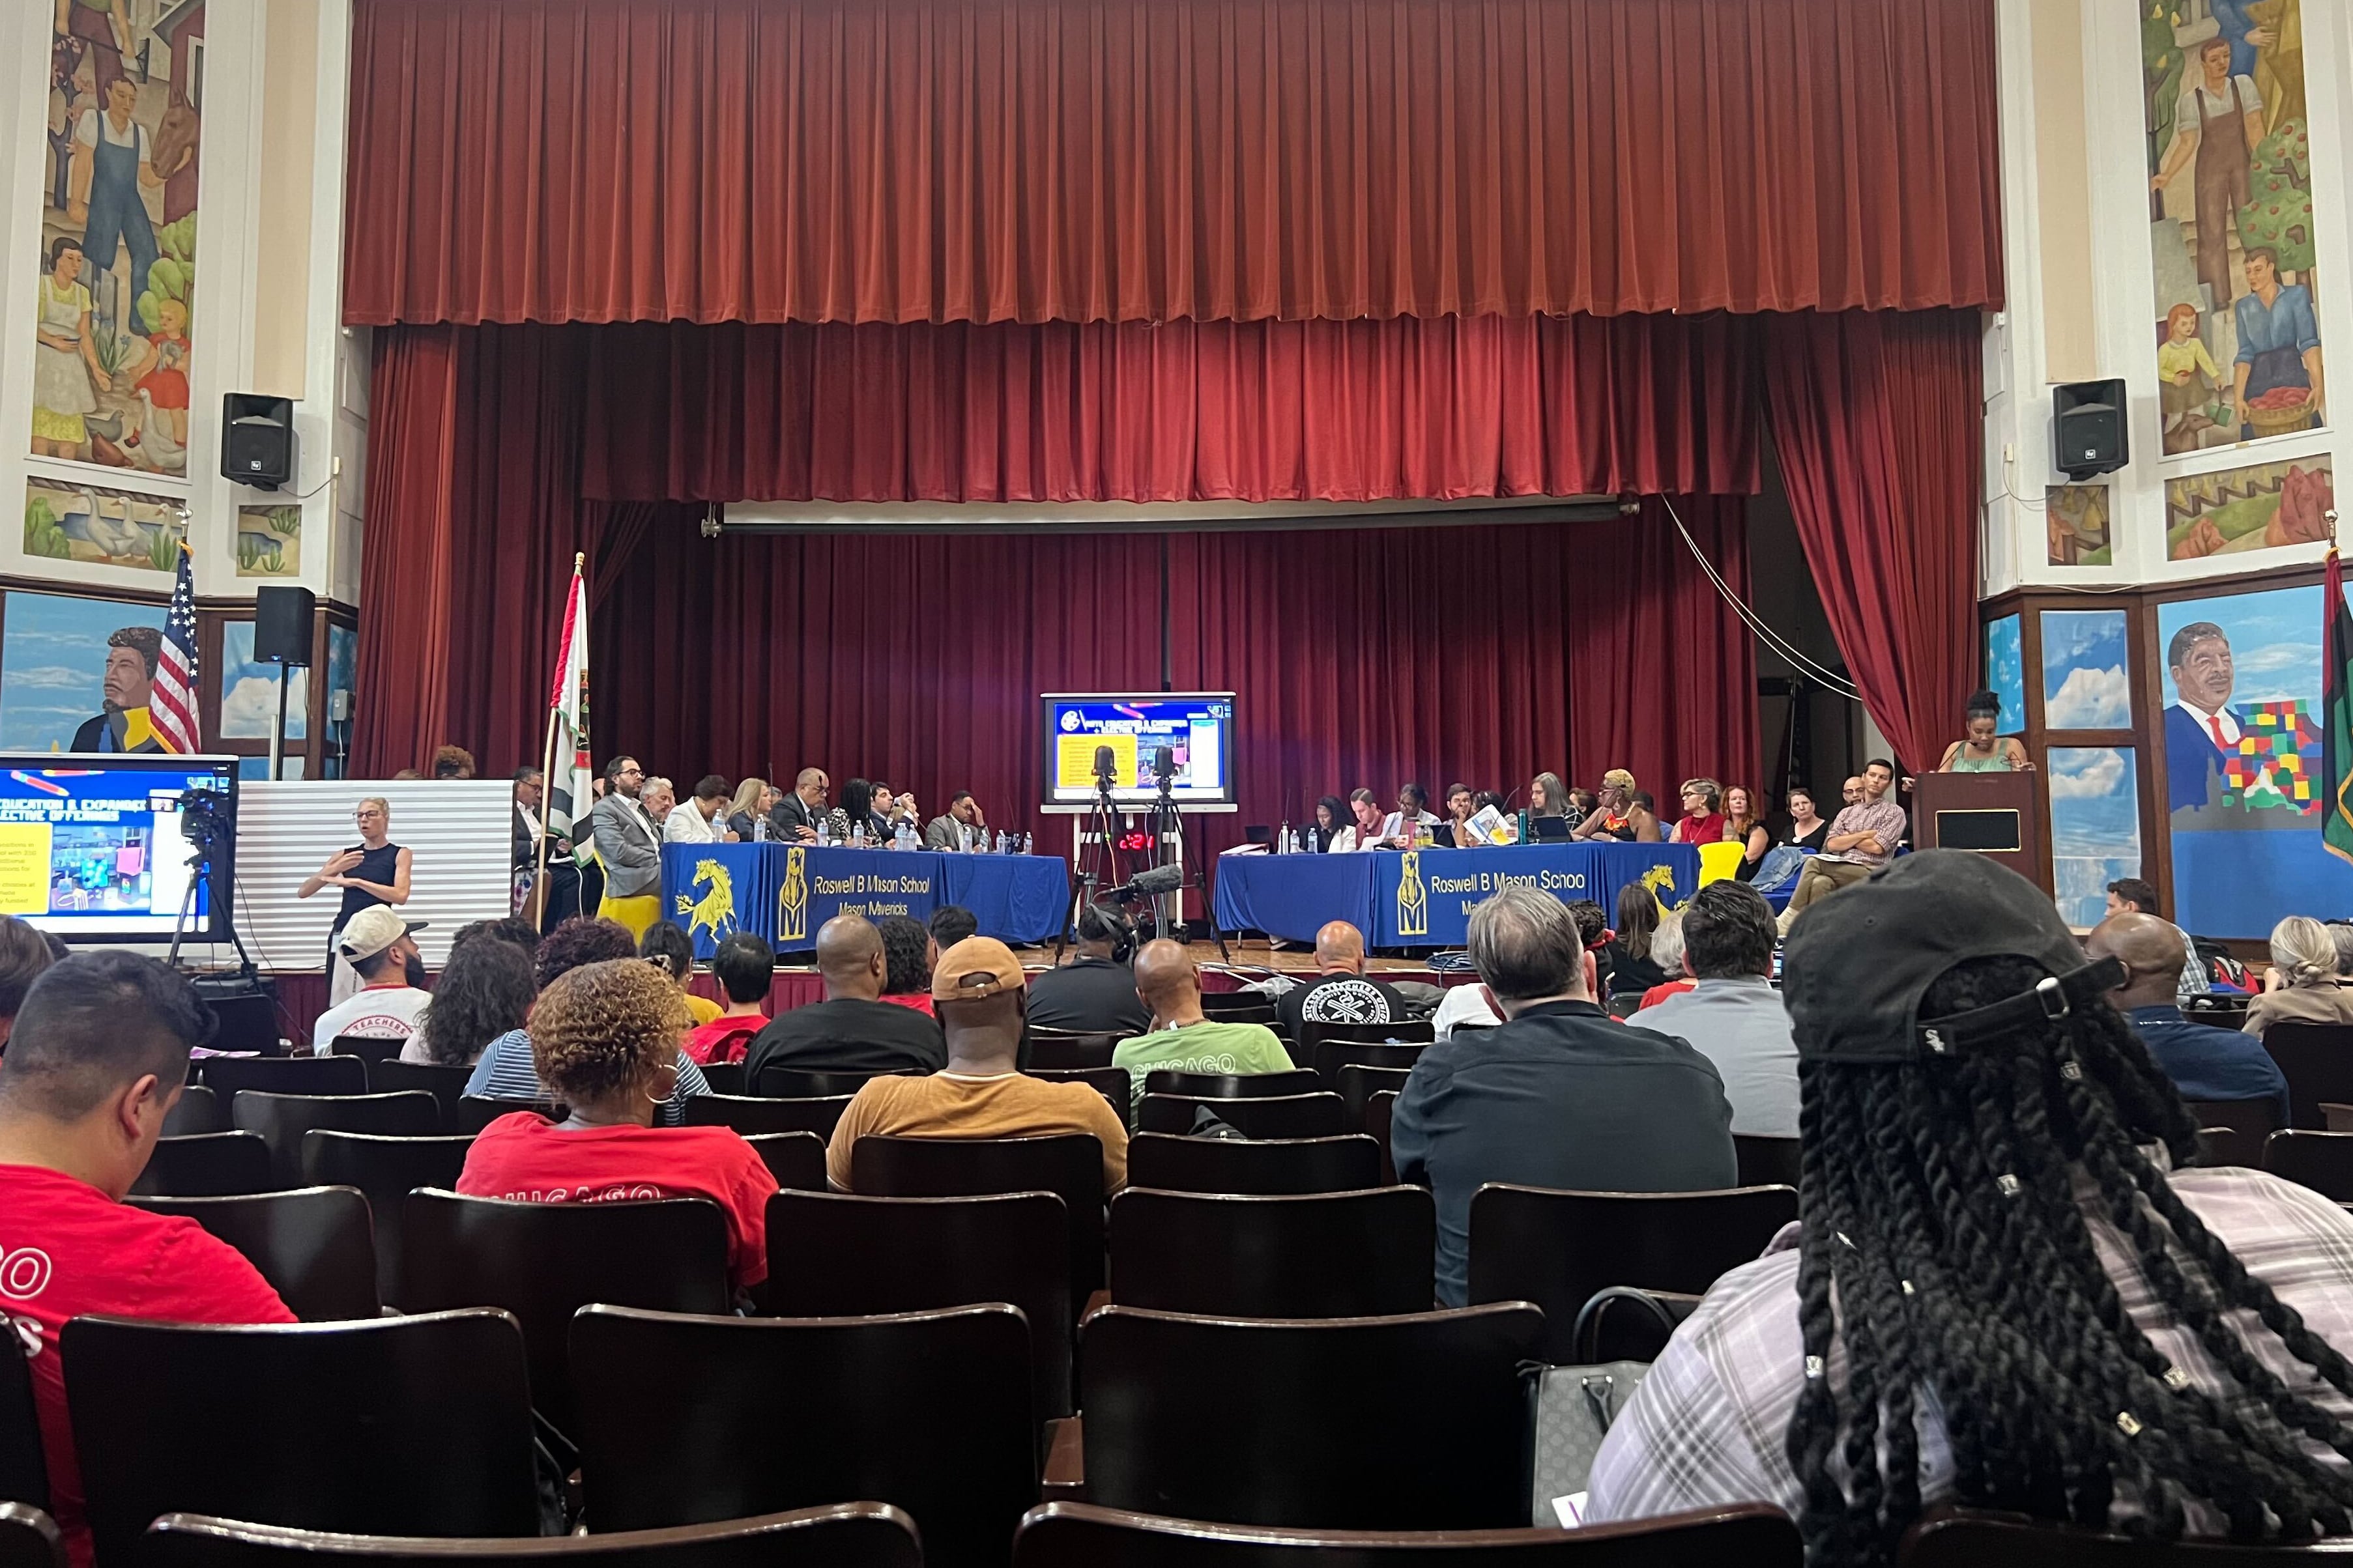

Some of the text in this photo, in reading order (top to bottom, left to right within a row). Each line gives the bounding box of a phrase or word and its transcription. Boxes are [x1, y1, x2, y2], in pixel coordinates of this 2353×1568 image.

[0, 810, 46, 821] ECTIVE
[814, 876, 855, 894] Roswell
[857, 875, 865, 893] B
[900, 876, 930, 894] School
[1432, 870, 1585, 893] Roswell B Mason Schoo
[839, 901, 908, 917] Mason Mavericks
[353, 1018, 406, 1034] TEACHERS
